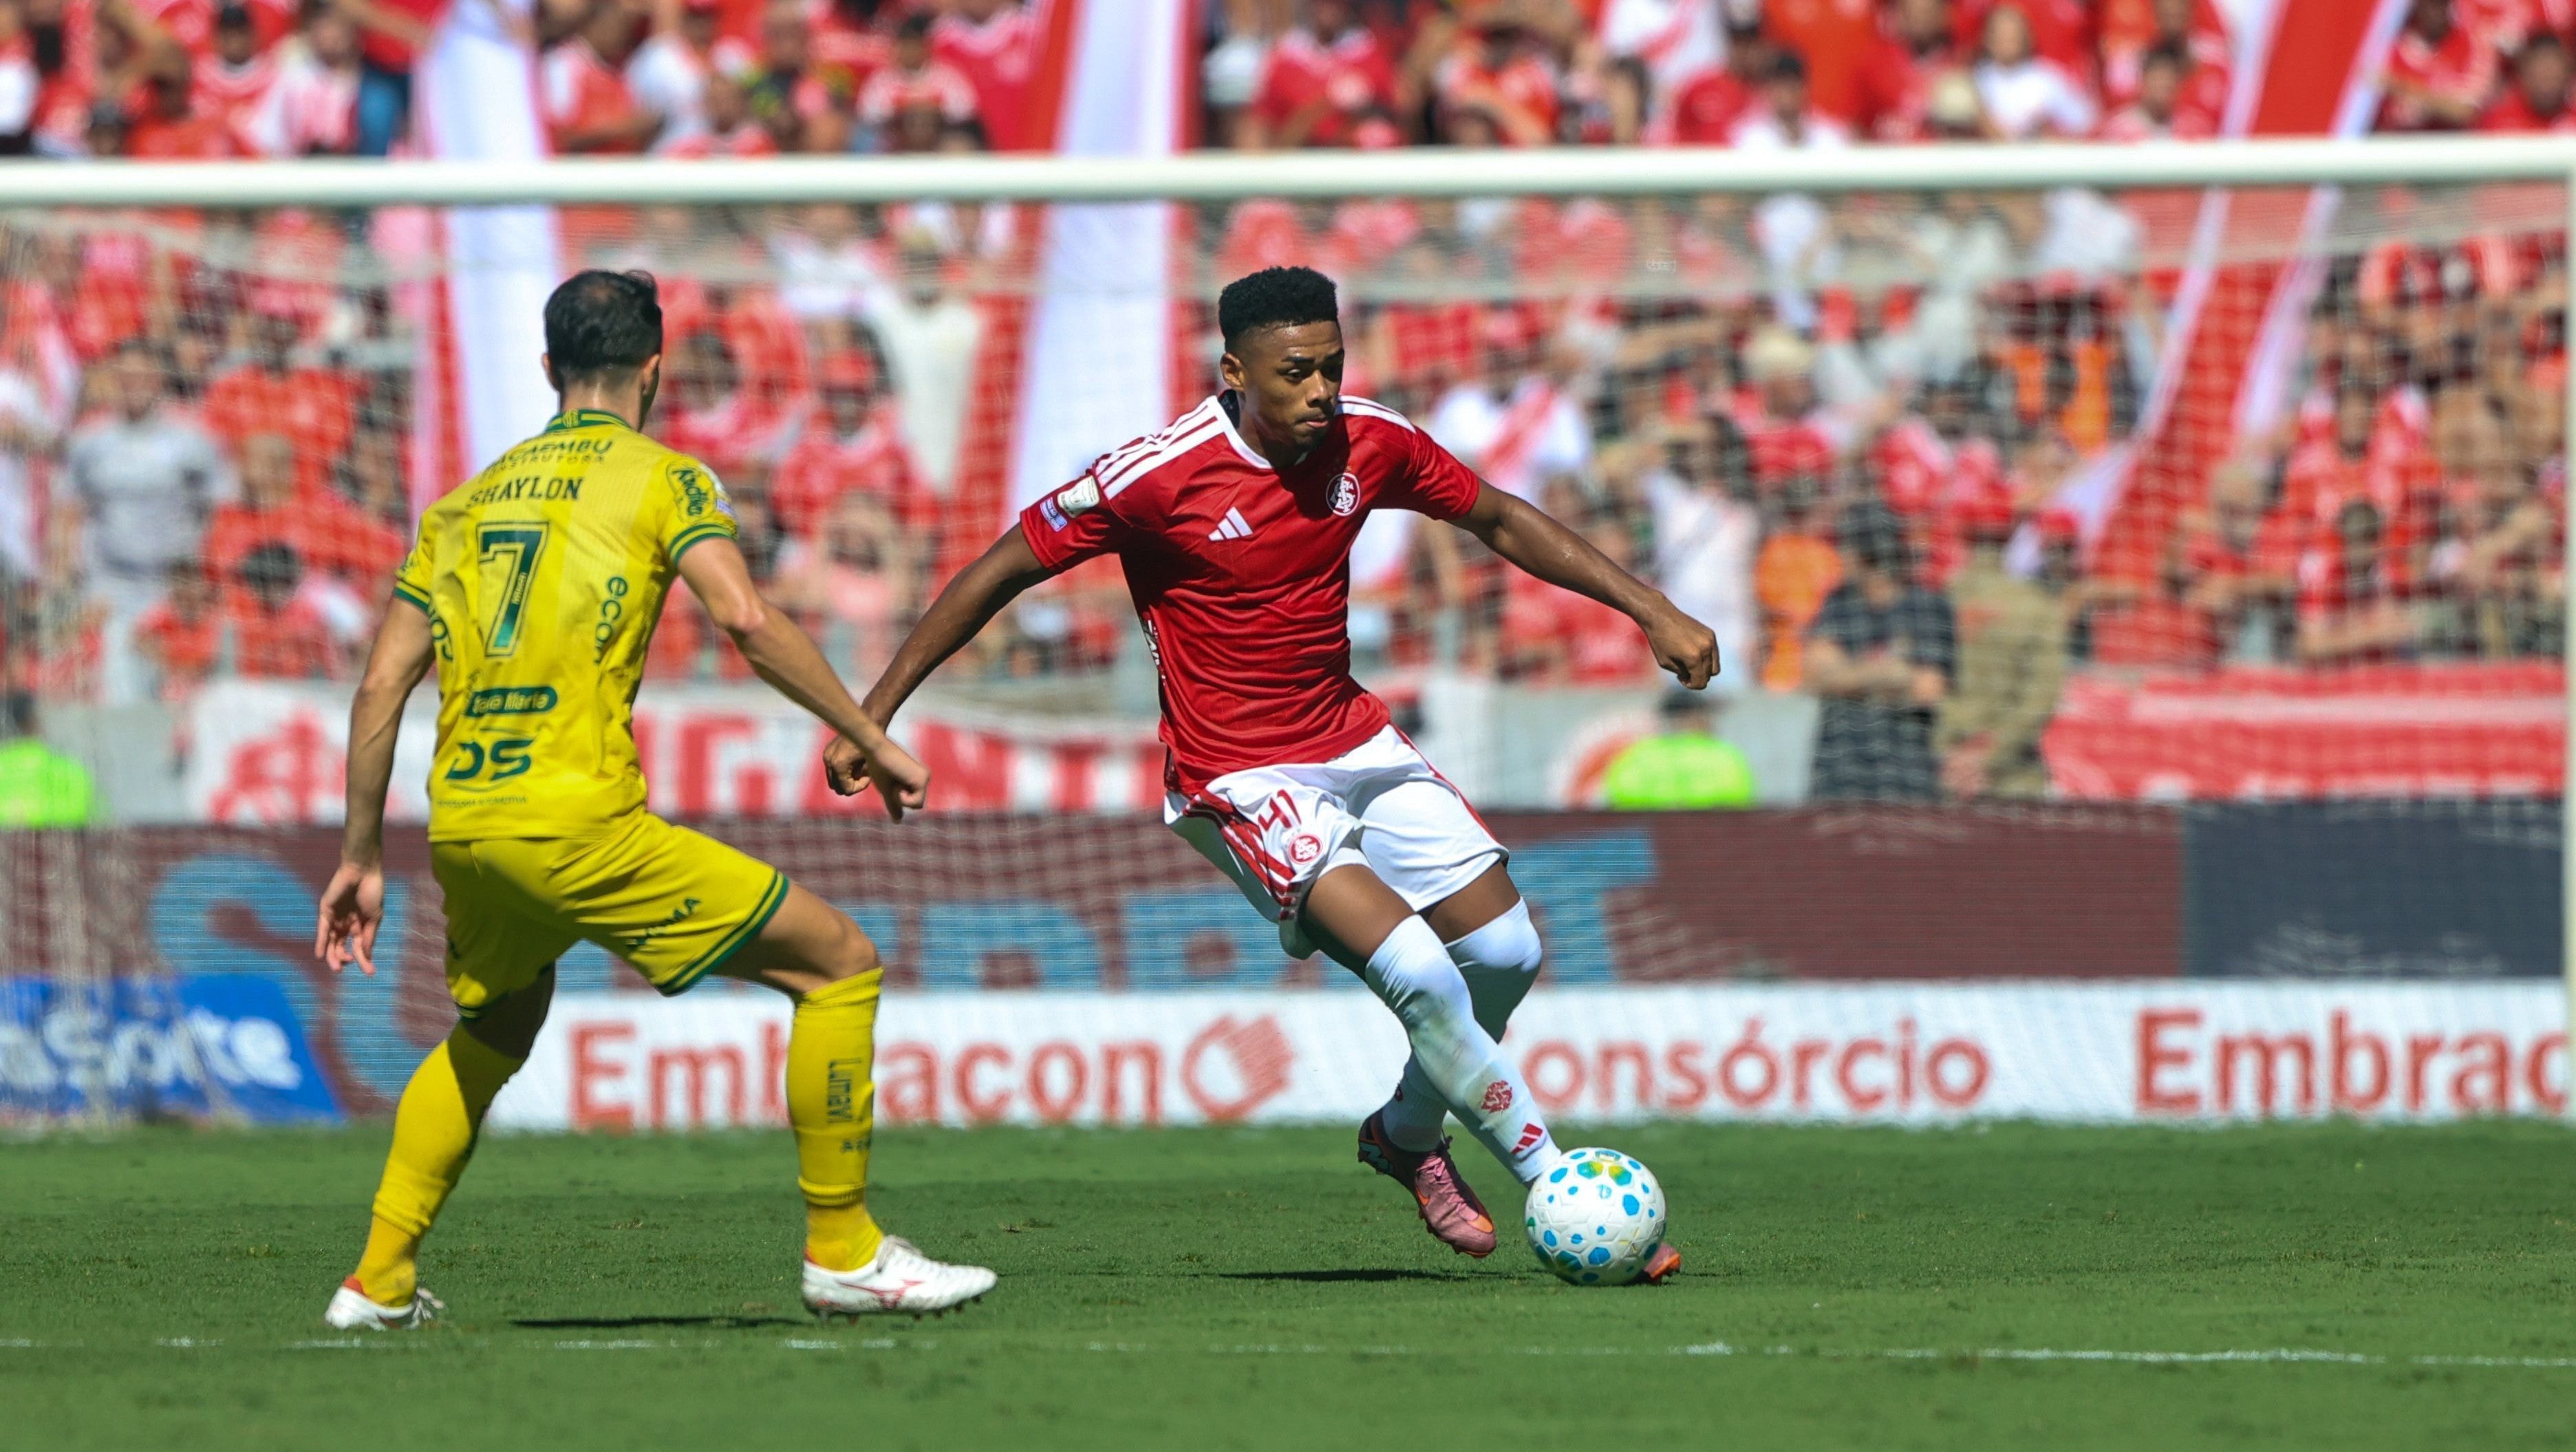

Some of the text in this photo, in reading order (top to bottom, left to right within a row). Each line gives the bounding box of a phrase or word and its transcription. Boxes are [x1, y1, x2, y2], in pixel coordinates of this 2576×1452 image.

[465, 475, 583, 510] SHAYLON
[475, 521, 550, 658] 7
[1257, 788, 1302, 832] 41
[1503, 1016, 1990, 1113] onsórcio
